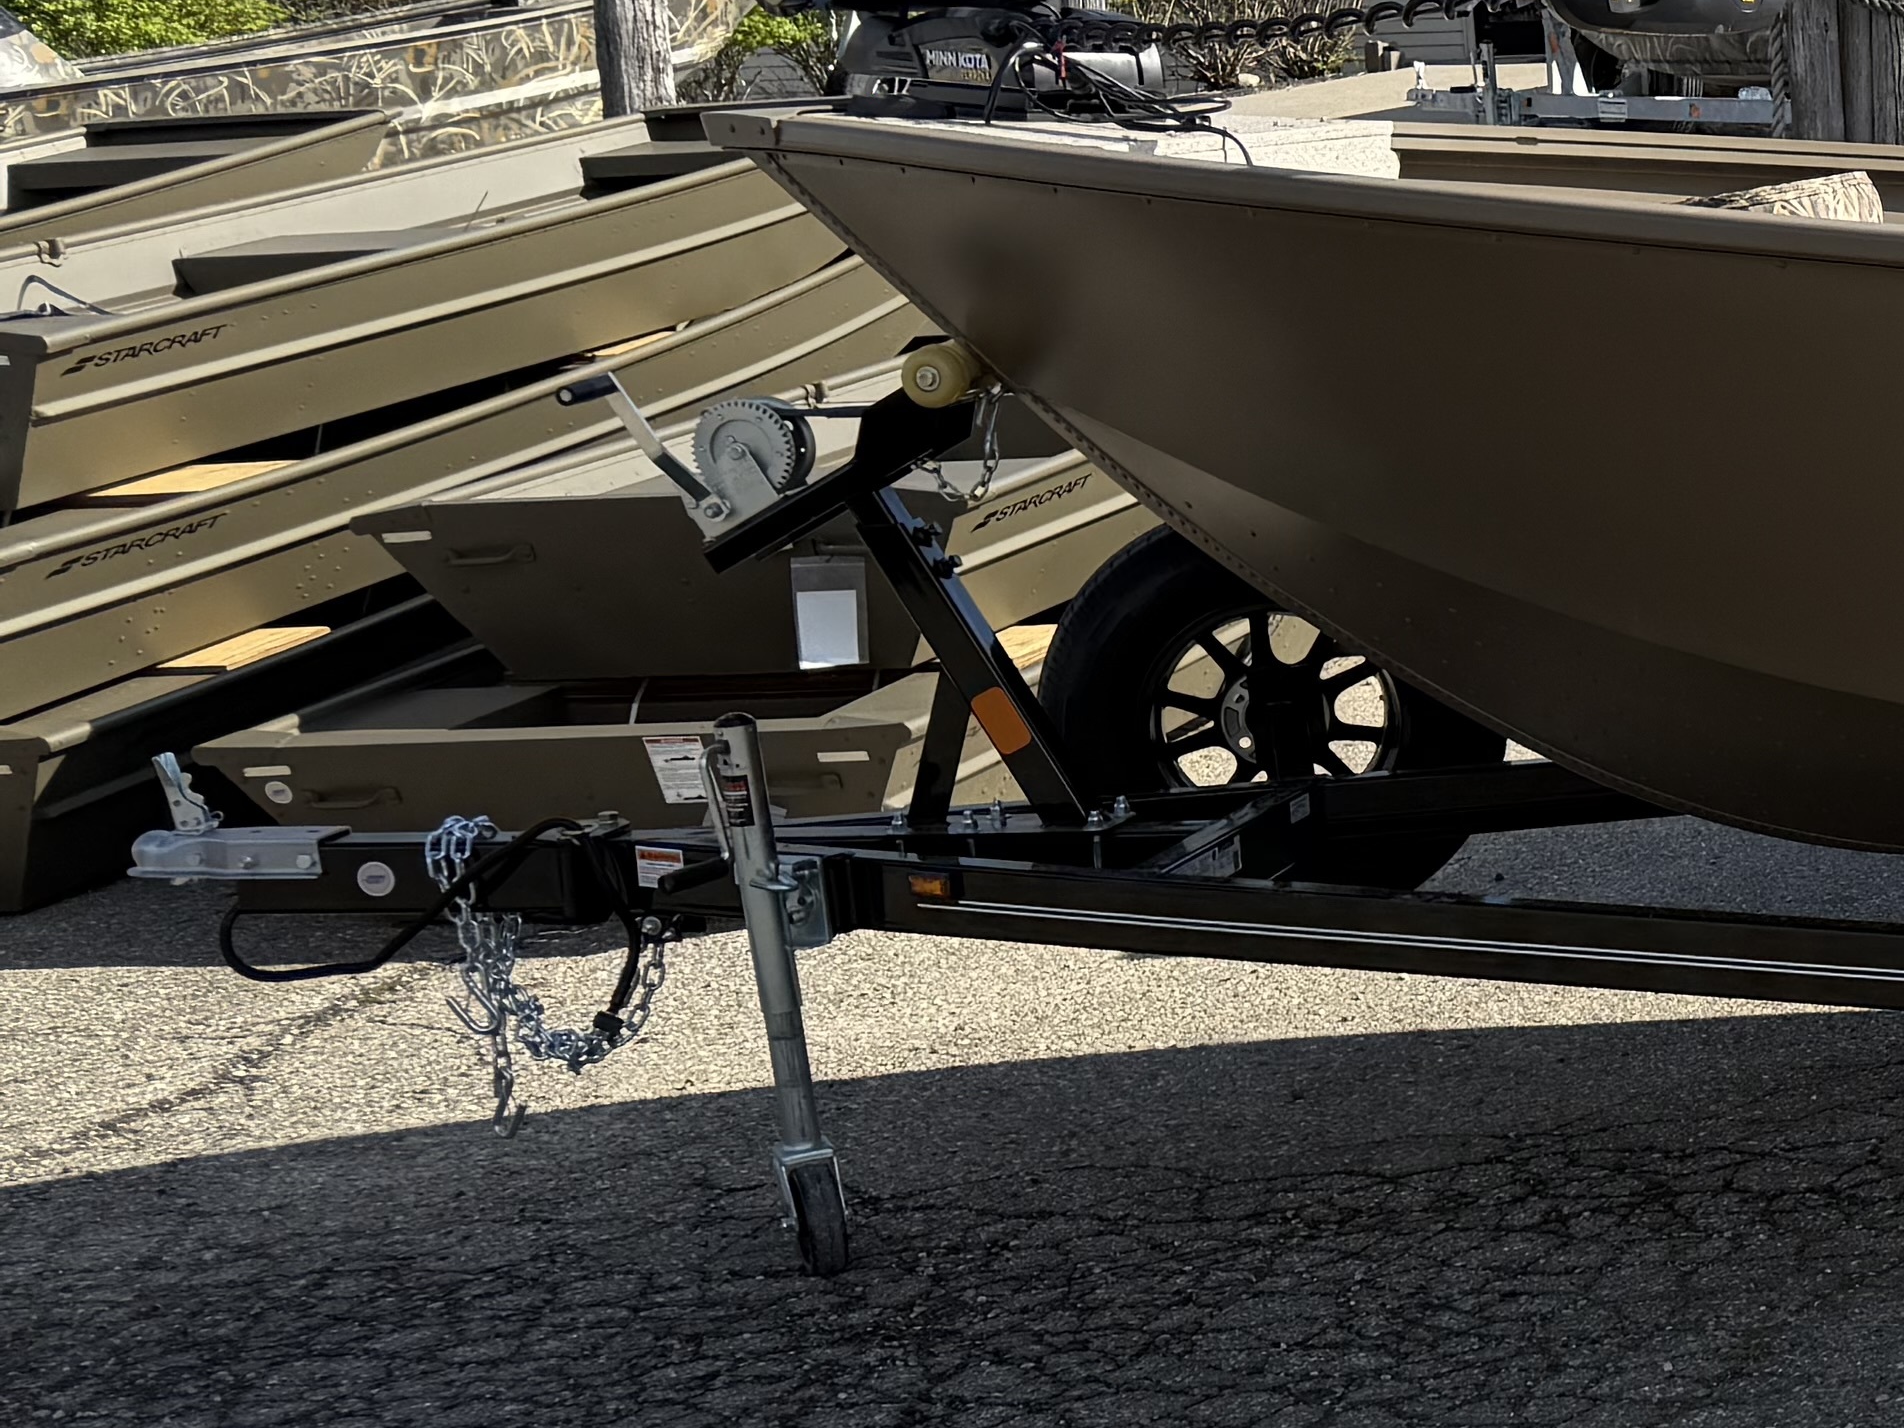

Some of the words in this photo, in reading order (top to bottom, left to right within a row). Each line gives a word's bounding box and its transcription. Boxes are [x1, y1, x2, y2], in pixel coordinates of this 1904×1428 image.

[926, 49, 957, 68] MINN
[958, 51, 990, 71] KOTA
[93, 324, 228, 368] STARCRAFT
[995, 473, 1092, 522] STARCRAFT
[81, 512, 228, 567] STARCRAFT
